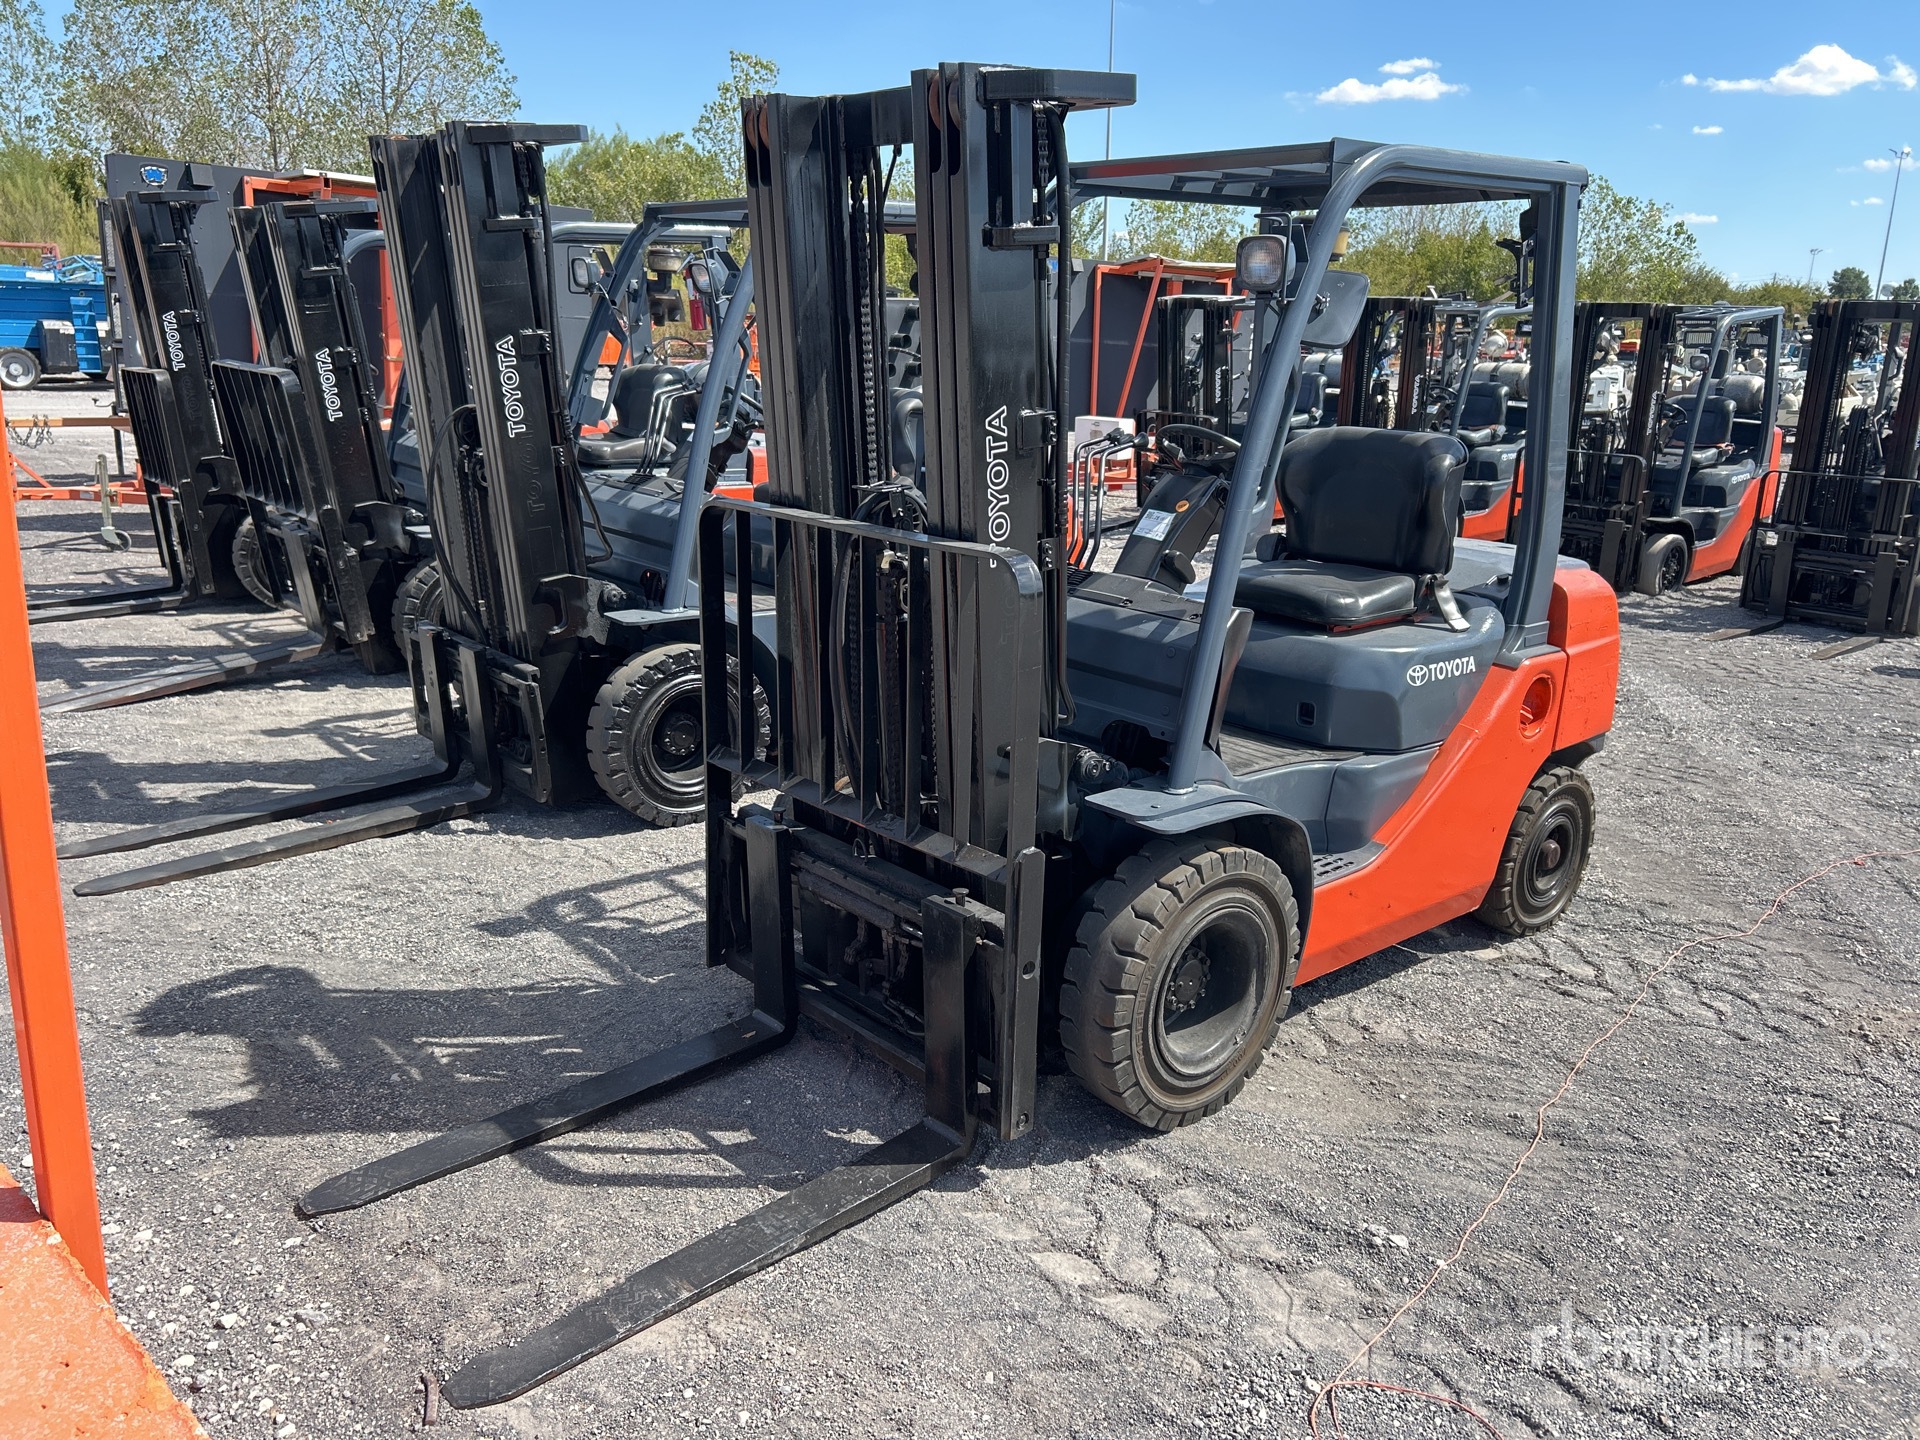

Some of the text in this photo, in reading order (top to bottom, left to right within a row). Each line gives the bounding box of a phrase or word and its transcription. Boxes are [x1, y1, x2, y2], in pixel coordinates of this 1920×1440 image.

[162, 311, 186, 371] TOYOTA
[315, 347, 344, 422] TOYOTA
[494, 335, 529, 438] TOYOTA
[1411, 374, 1421, 414] TOYOTA
[1646, 391, 1657, 435] TOYOTA
[1429, 656, 1476, 681] TOYOTA
